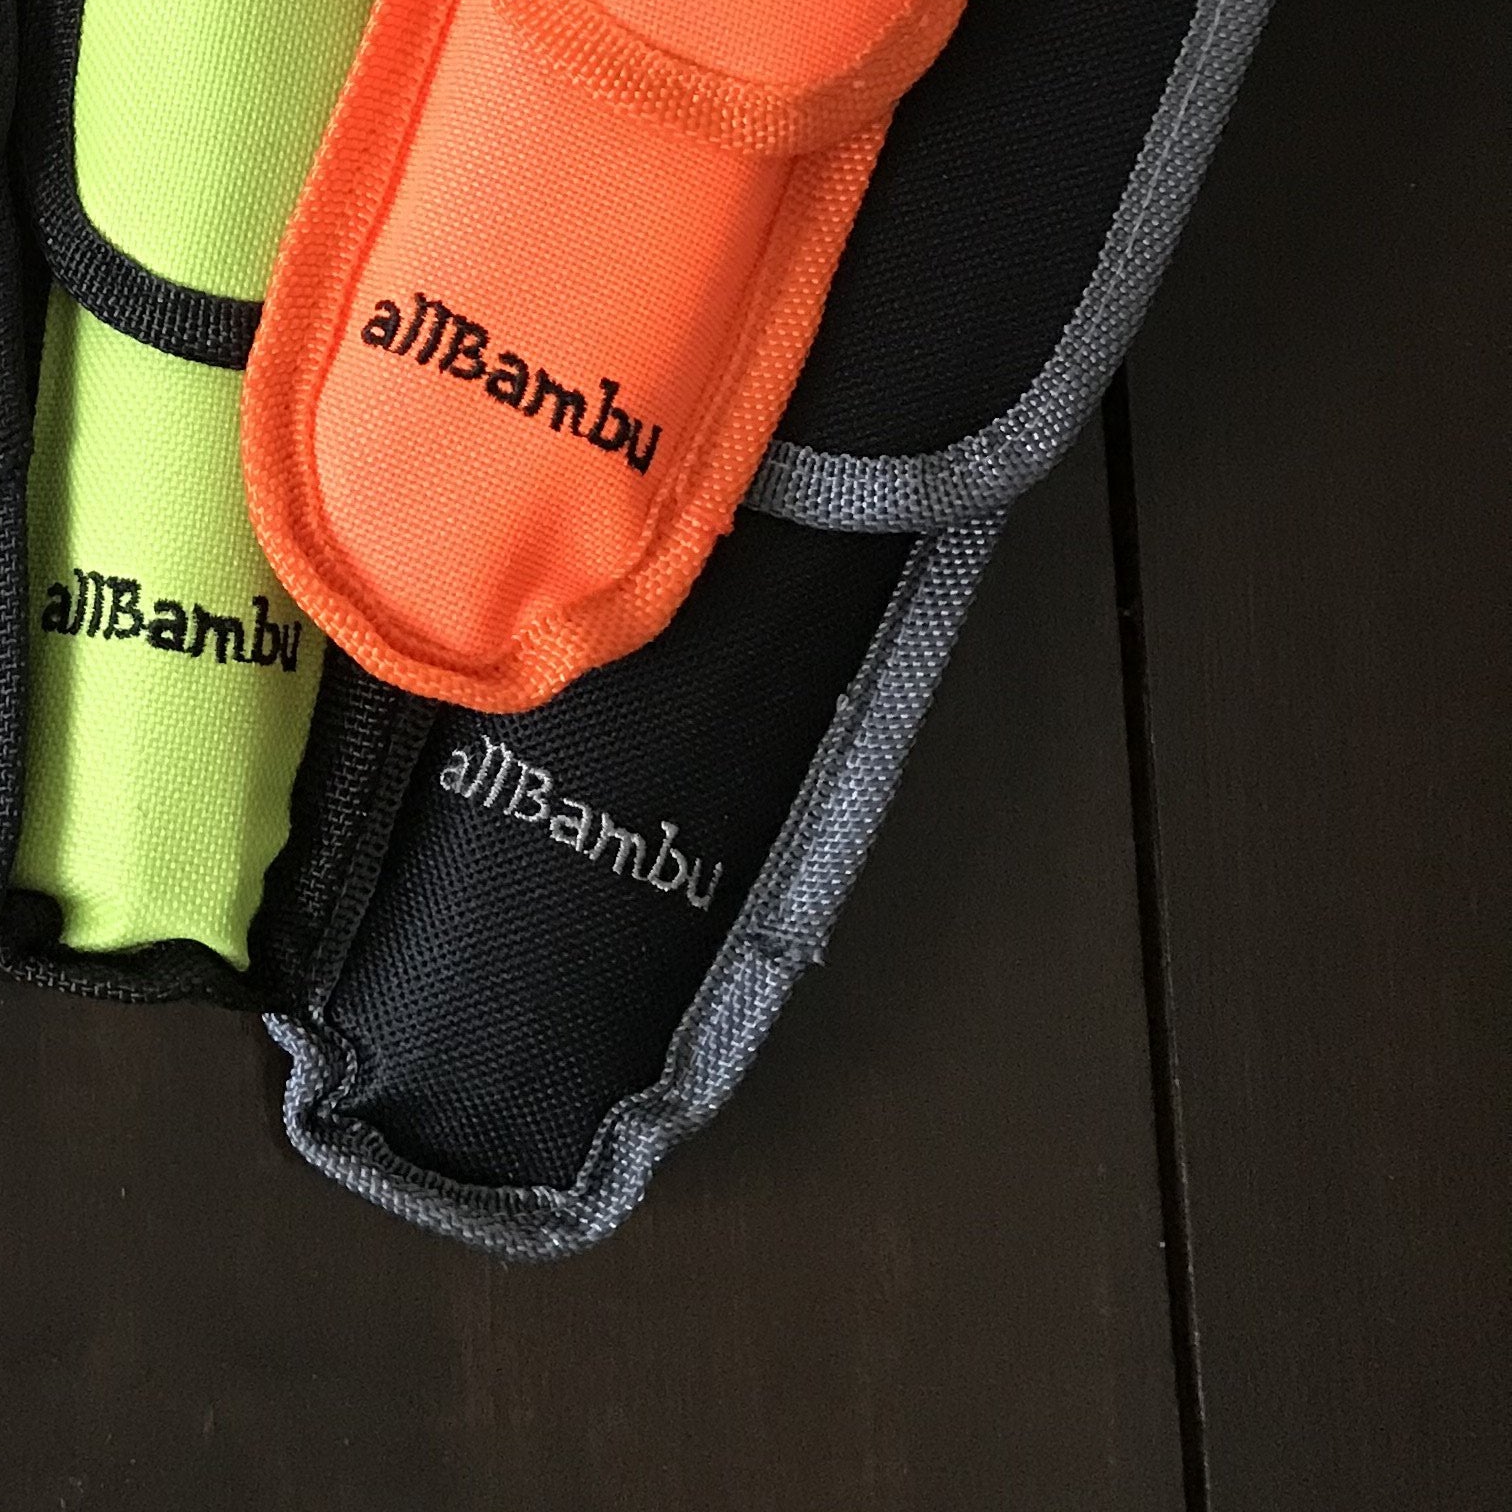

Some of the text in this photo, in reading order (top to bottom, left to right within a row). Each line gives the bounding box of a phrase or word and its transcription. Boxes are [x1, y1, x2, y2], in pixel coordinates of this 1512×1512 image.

[361, 292, 663, 476] allBambu
[42, 567, 302, 672] allBambu
[440, 734, 723, 911] allBambu
